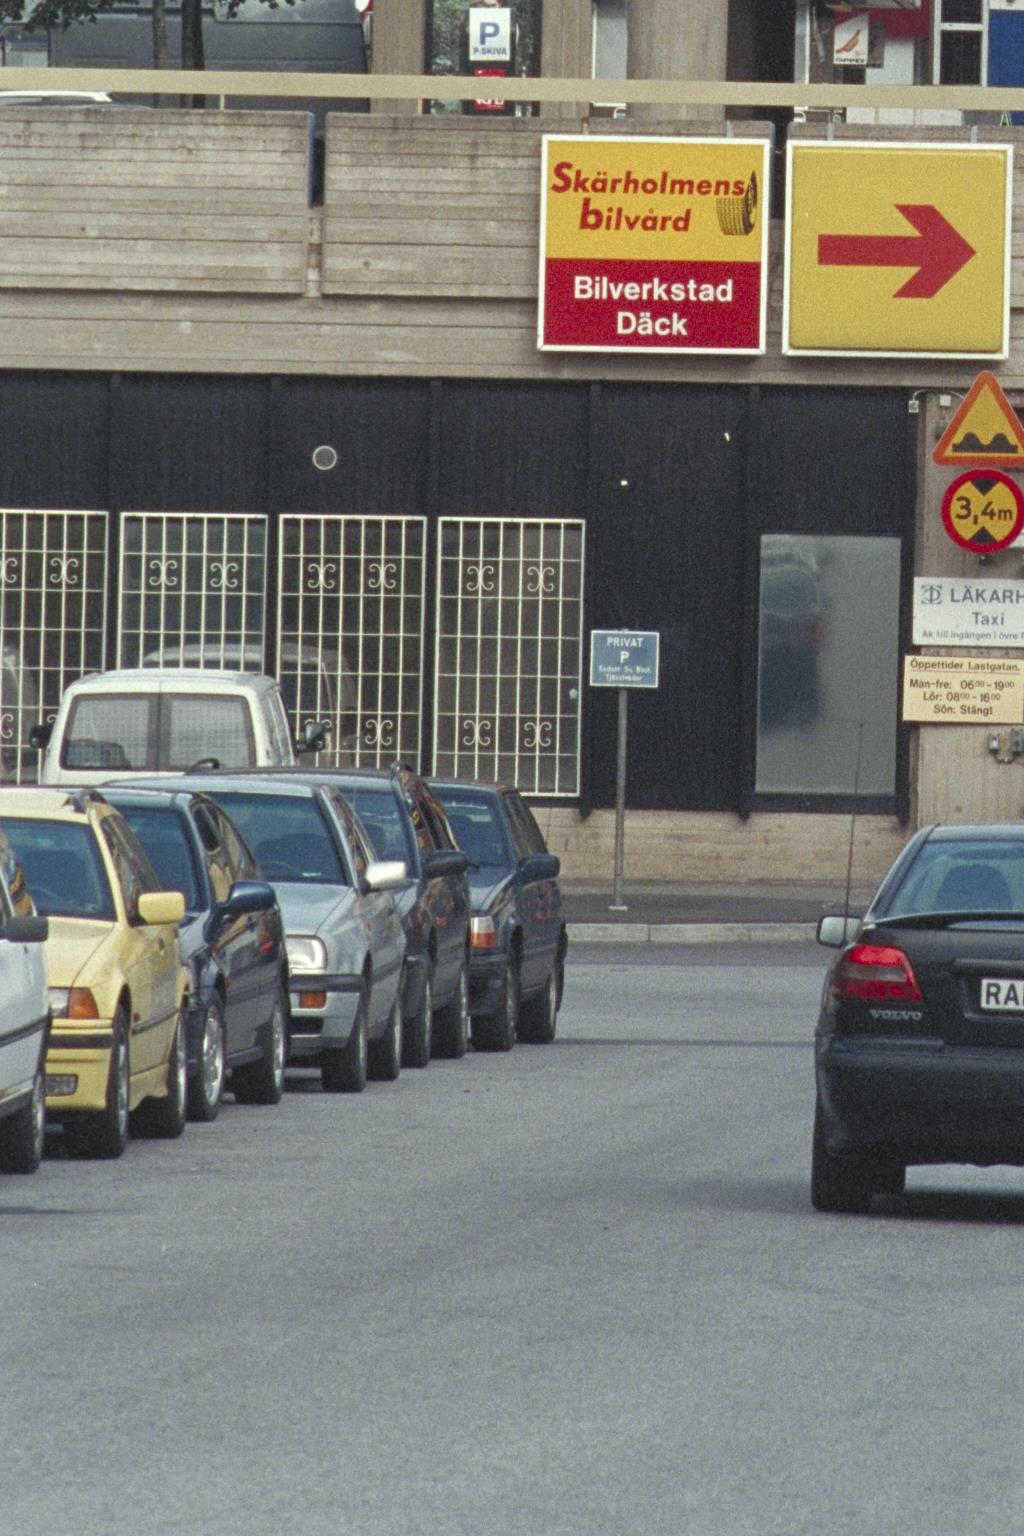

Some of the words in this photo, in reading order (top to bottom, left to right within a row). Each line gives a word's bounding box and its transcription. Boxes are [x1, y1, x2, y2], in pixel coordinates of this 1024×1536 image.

[479, 22, 501, 45] P
[473, 47, 508, 56] P-SKIVA
[551, 161, 745, 196] Skärholmens
[579, 197, 692, 233] bilvård
[574, 275, 734, 303] Bilverkstad
[616, 311, 688, 337] Däck
[971, 611, 1005, 626] Taxi
[606, 636, 644, 648] PRIVAT
[620, 650, 630, 664] P
[910, 657, 964, 671] Öppettider
[923, 690, 943, 702] Lör:
[933, 704, 956, 714] Sön:
[960, 704, 993, 717] Stängt
[870, 1008, 922, 1021] VOLVO
